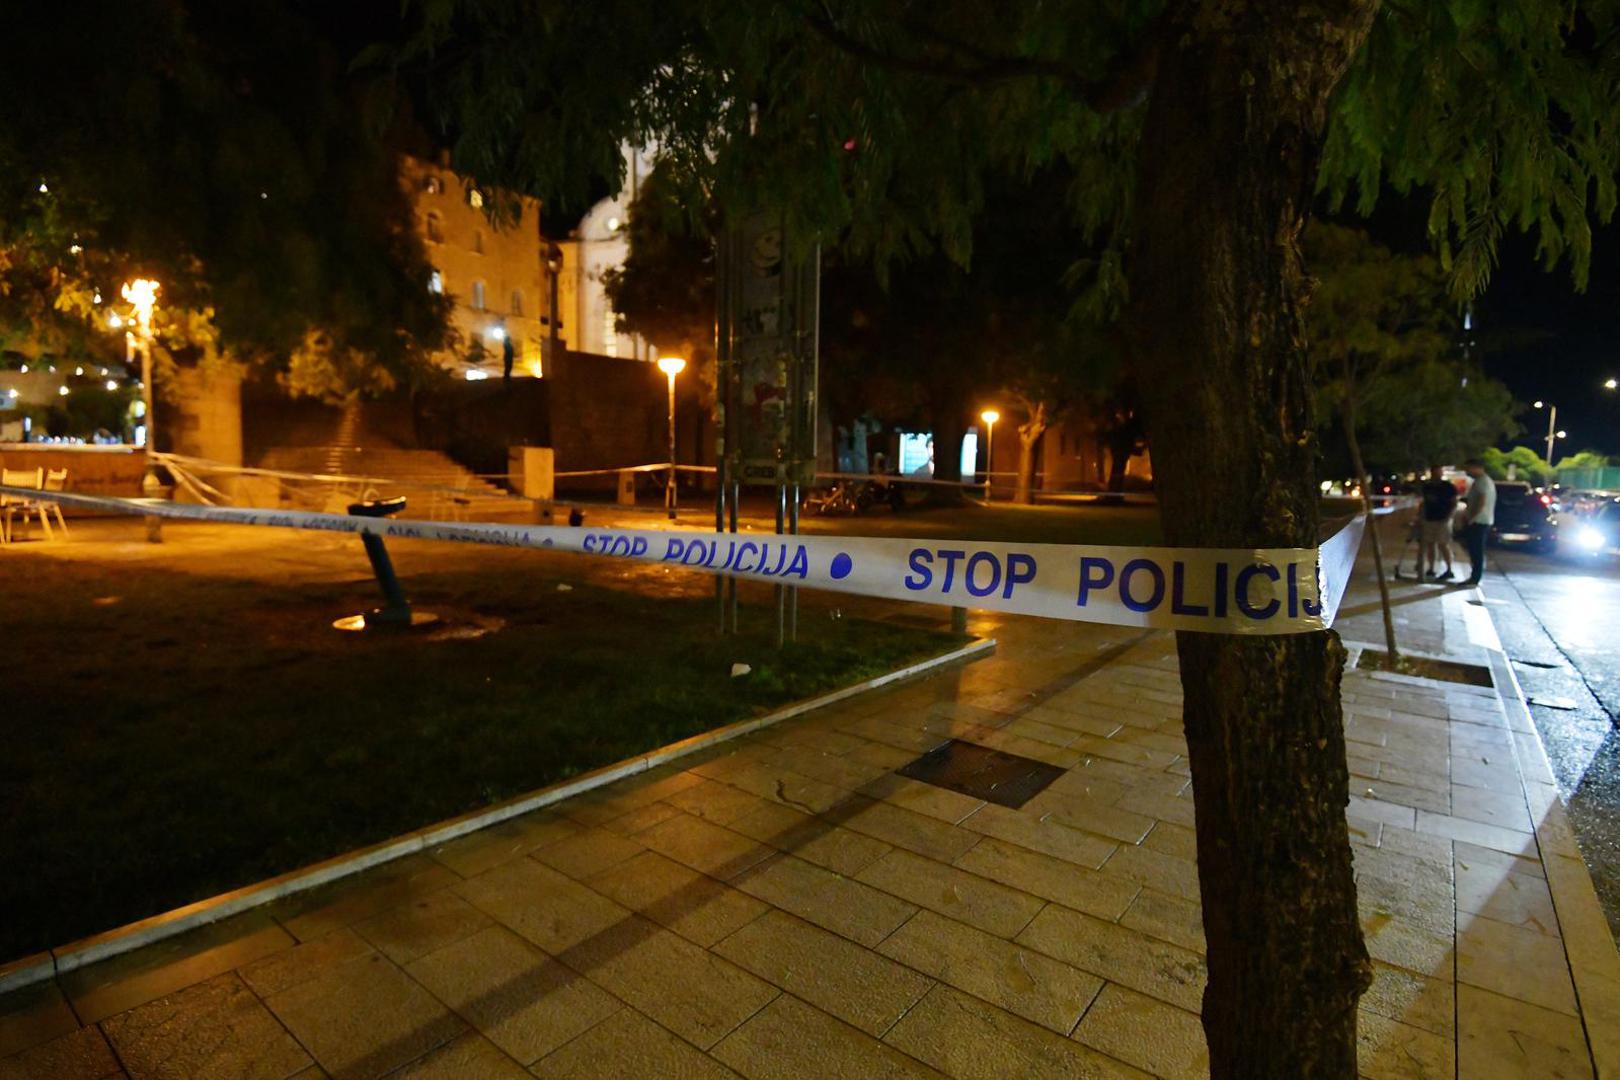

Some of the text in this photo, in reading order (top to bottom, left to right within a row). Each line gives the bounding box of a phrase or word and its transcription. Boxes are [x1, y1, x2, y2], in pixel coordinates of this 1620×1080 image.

[583, 533, 648, 559] STOP
[662, 538, 808, 580] POLICIJA
[904, 548, 1037, 600] STOP
